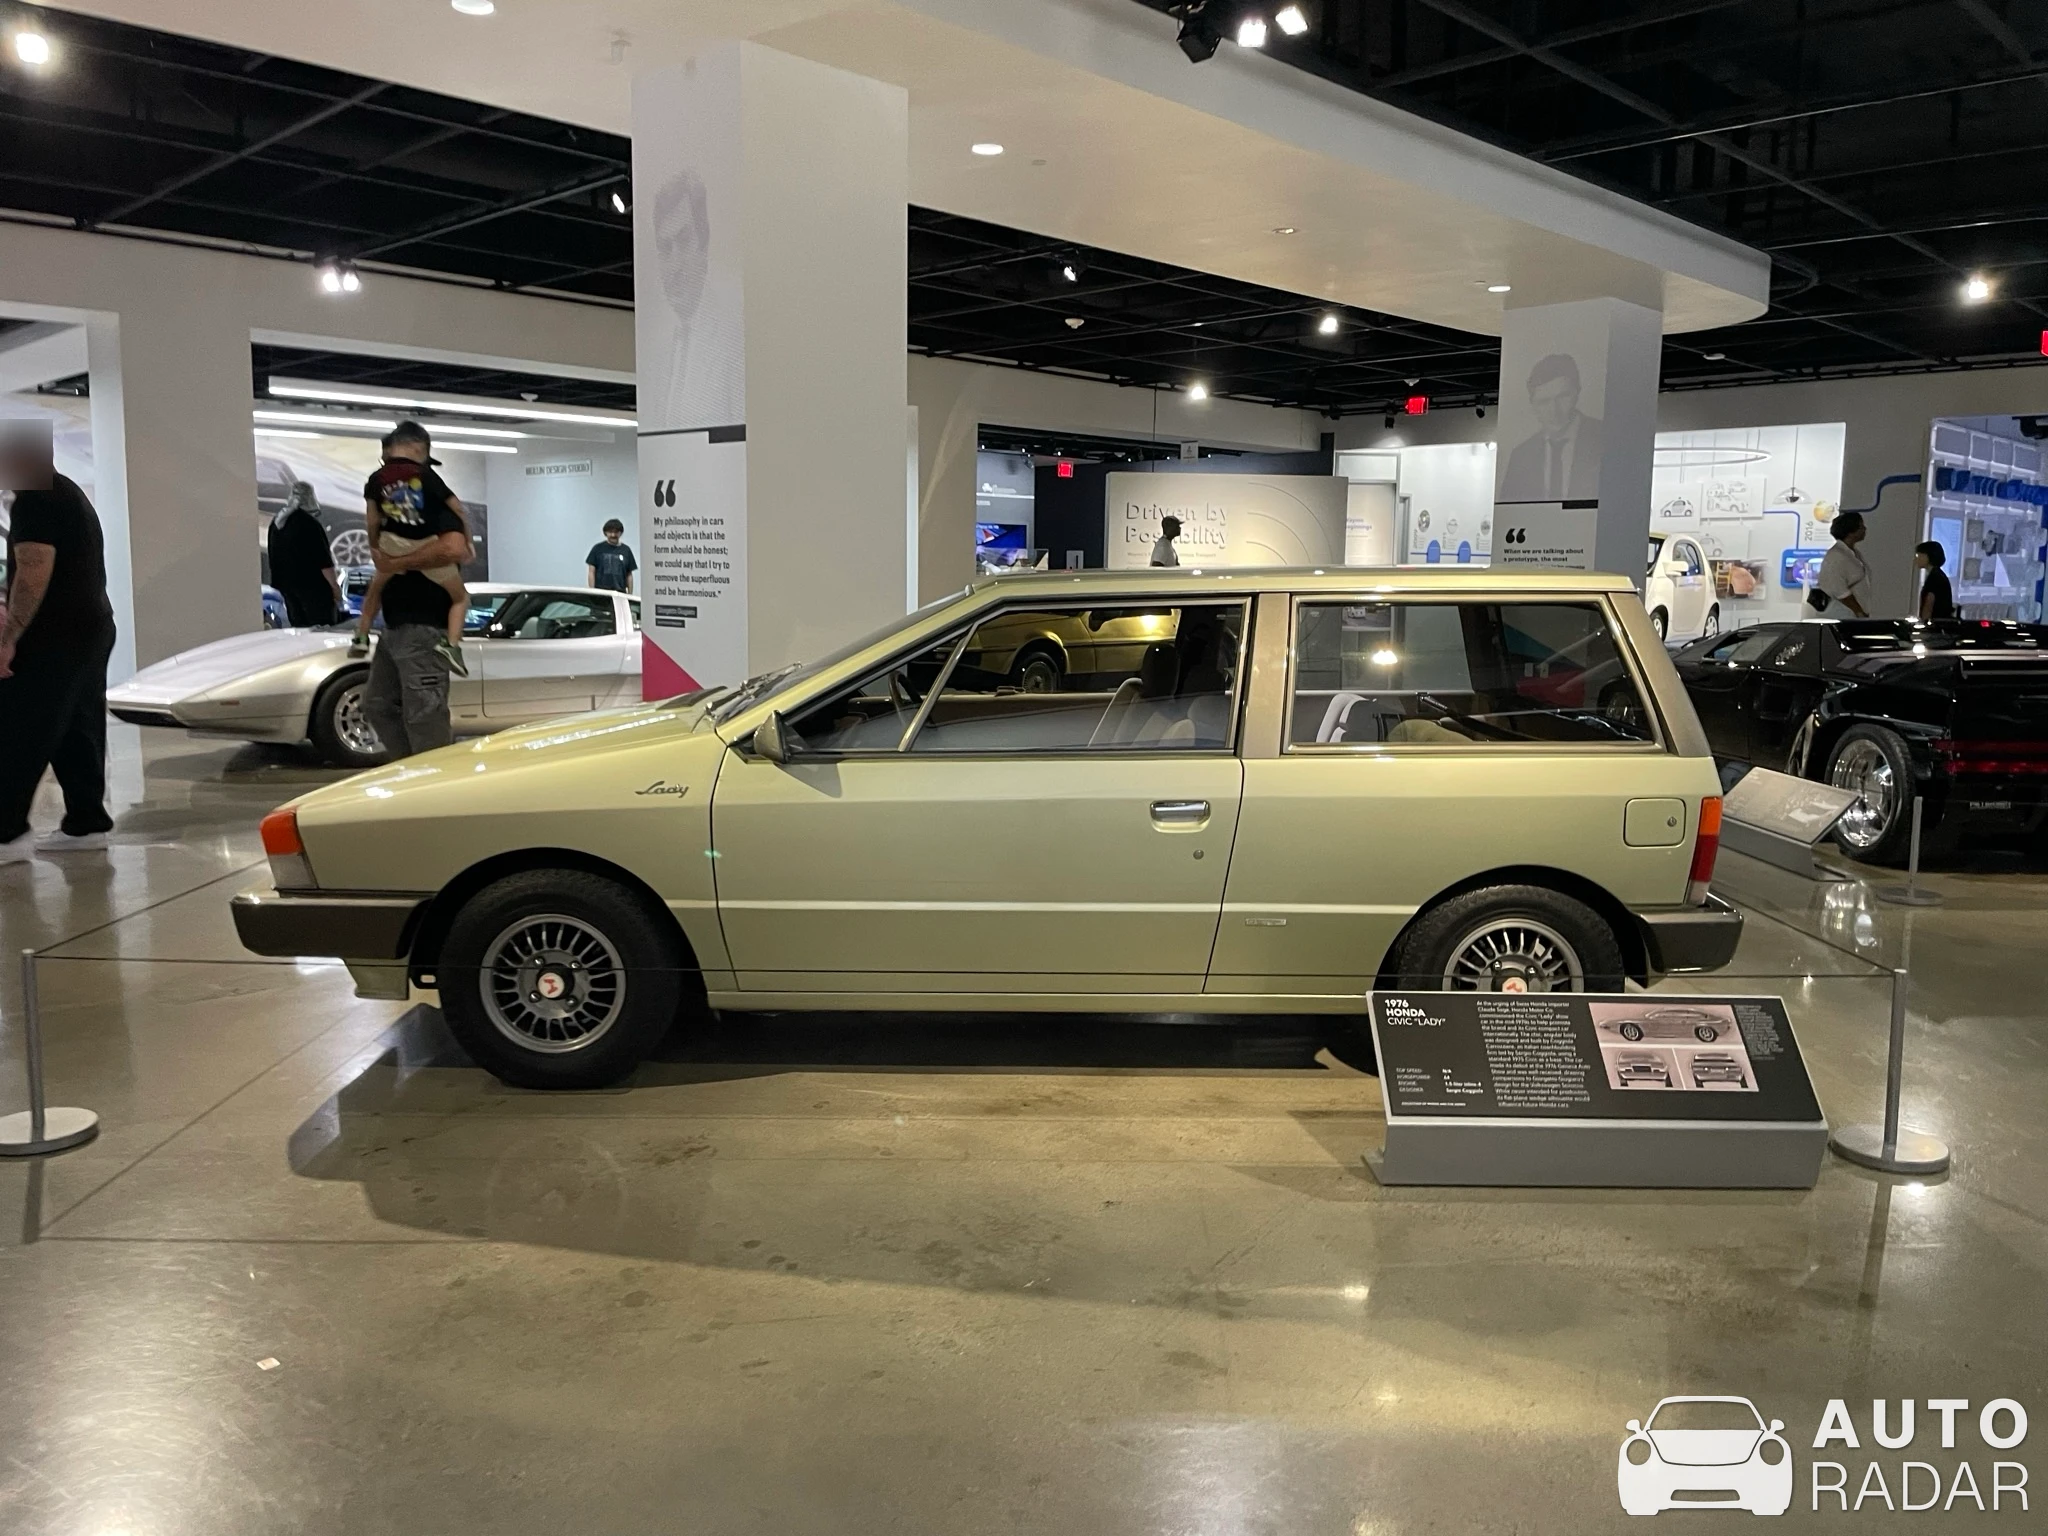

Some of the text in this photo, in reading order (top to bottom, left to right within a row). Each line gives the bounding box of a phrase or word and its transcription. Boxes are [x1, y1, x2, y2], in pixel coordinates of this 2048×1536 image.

[1126, 502, 1227, 526] Driven by
[654, 517, 663, 527] My
[664, 516, 700, 527] philosophy
[702, 516, 708, 525] in
[654, 530, 725, 541] and objects is that the
[1126, 526, 1227, 550] Posbility
[654, 544, 728, 555] form should be honest;
[664, 559, 682, 568] could
[683, 561, 693, 570] say
[695, 559, 708, 568] that
[709, 560, 711, 568] I
[712, 561, 721, 570] try
[680, 573, 690, 582] the
[691, 574, 730, 584] superfluous
[655, 586, 666, 595] and
[668, 587, 676, 596] be
[634, 780, 690, 798] Lady
[1385, 999, 1409, 1008] 1976
[1386, 1009, 1426, 1017] HONDA
